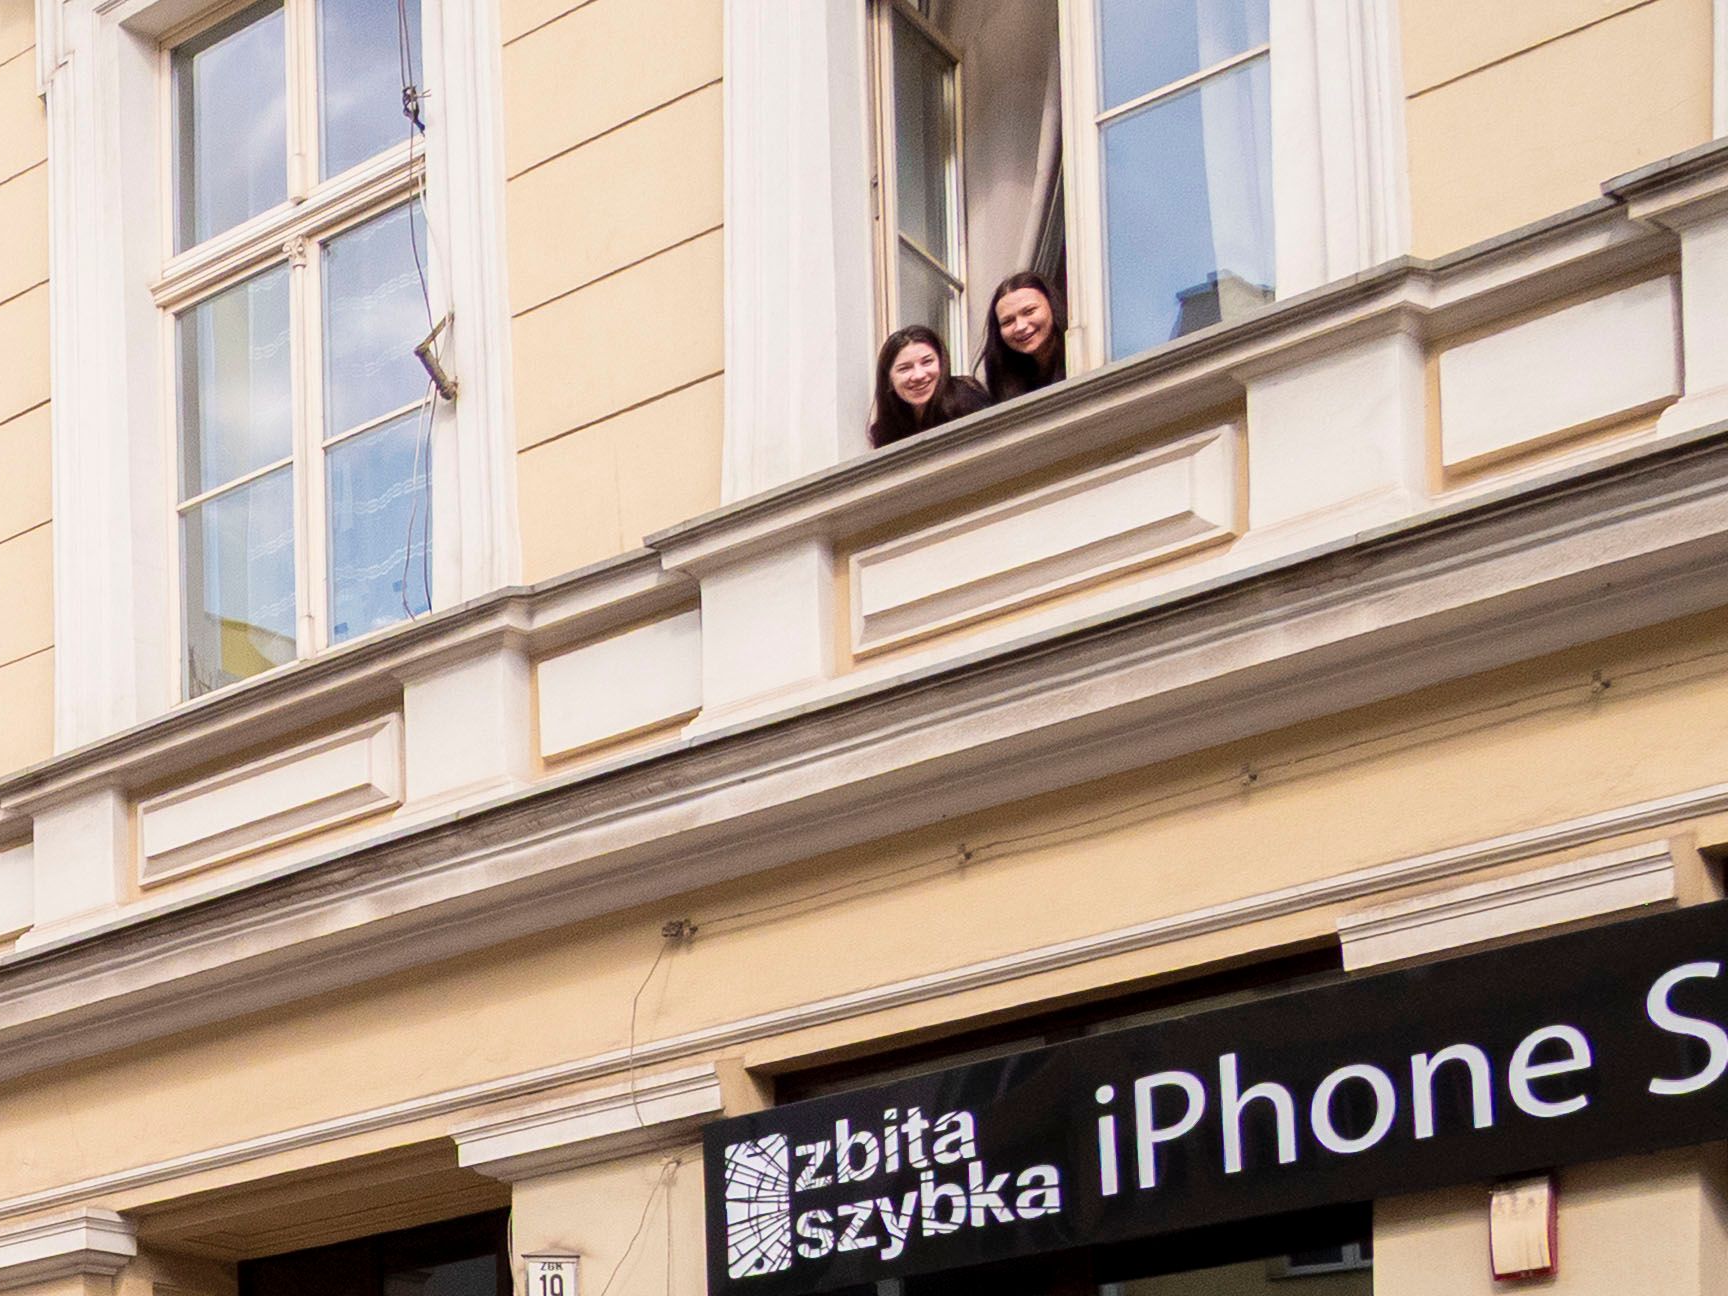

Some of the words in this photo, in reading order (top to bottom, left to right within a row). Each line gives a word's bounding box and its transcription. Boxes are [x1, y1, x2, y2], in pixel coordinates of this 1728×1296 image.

[795, 1106, 977, 1192] zbita
[1095, 1024, 1593, 1196] iPhone
[796, 1160, 1061, 1261] szybka
